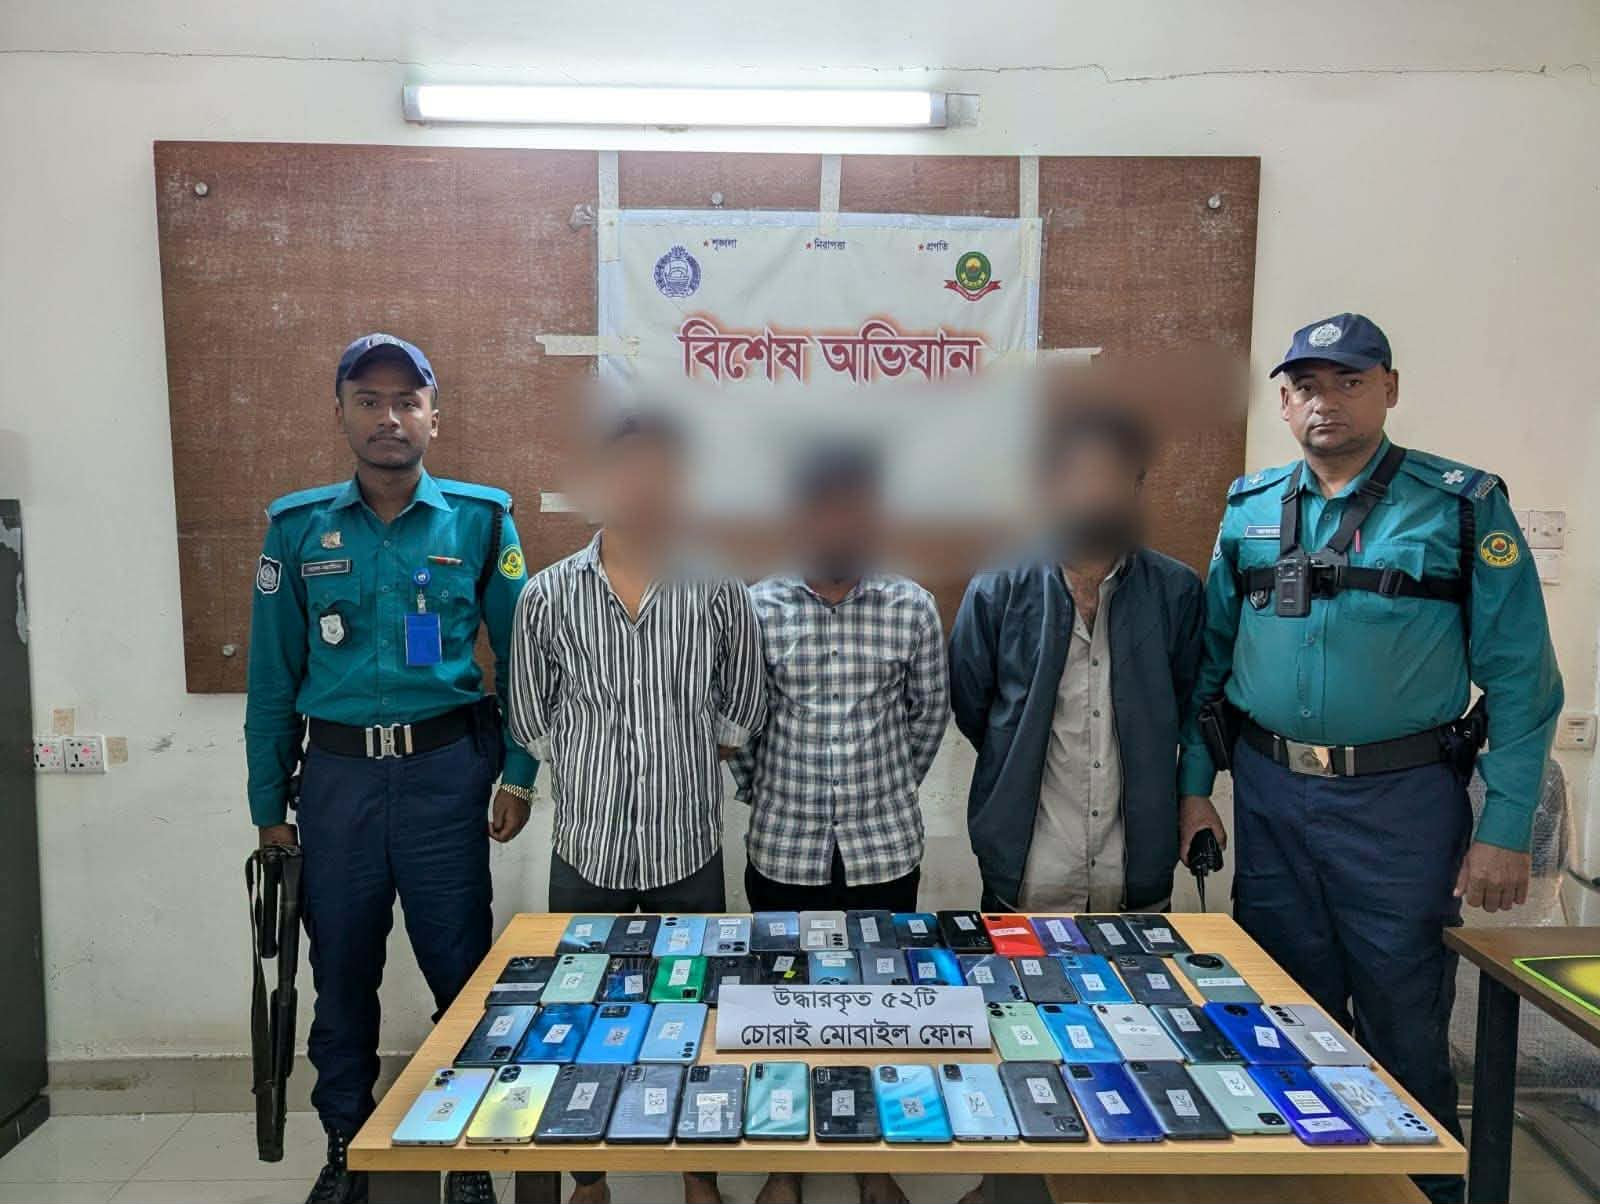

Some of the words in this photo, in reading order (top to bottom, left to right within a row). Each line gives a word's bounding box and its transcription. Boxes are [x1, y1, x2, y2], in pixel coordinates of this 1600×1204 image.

[926, 240, 950, 252] প্রগতি
[678, 319, 808, 381] বিশেষ
[818, 320, 982, 382] অভিযান
[773, 986, 873, 1016] উদ্ধারকৃত
[881, 987, 938, 1010] ৫২টি
[741, 1019, 812, 1046] চোরাই
[820, 1019, 910, 1046] মোবাইল
[919, 1023, 974, 1047] ফোন
